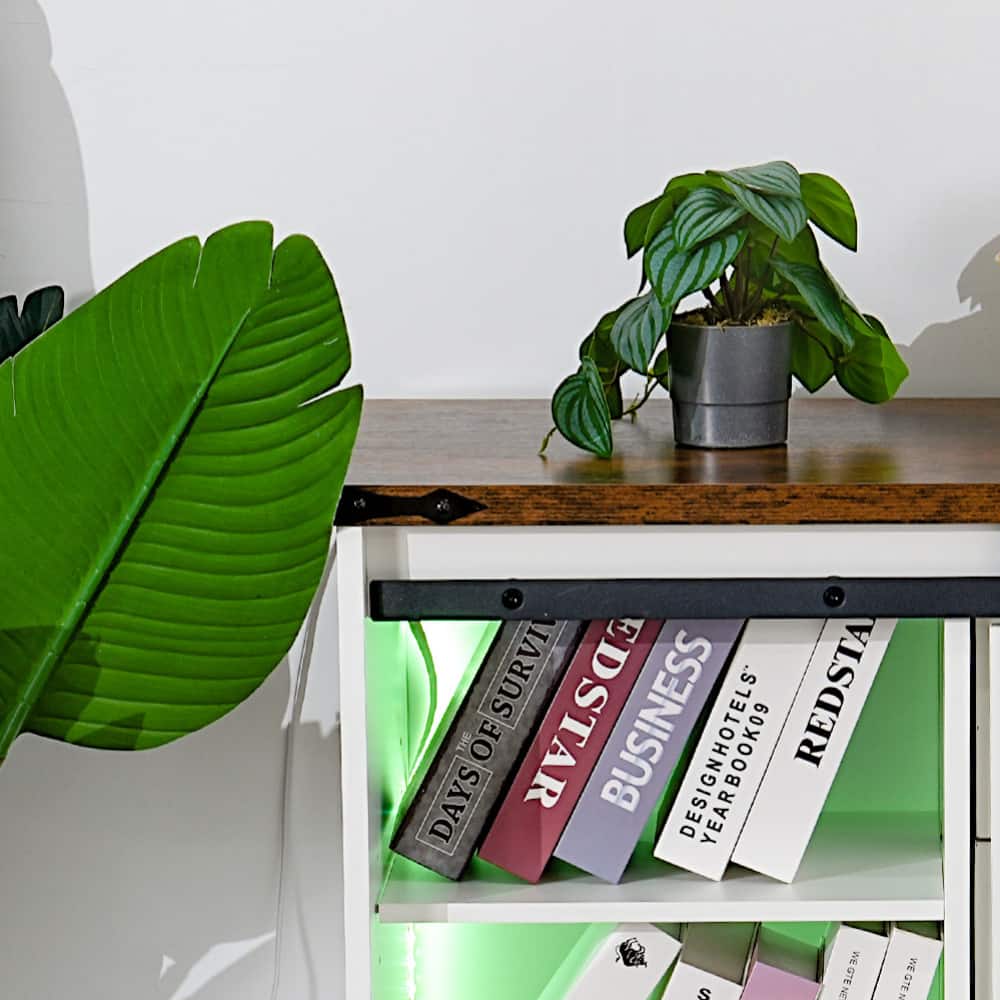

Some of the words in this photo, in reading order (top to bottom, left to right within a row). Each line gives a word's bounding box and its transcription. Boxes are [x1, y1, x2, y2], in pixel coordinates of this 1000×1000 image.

[601, 629, 712, 812] BUSINESS
[456, 731, 471, 751] THE
[428, 765, 480, 843] DAYS
[470, 719, 502, 761] OF
[850, 951, 860, 965] WE
[907, 958, 918, 973] WE
